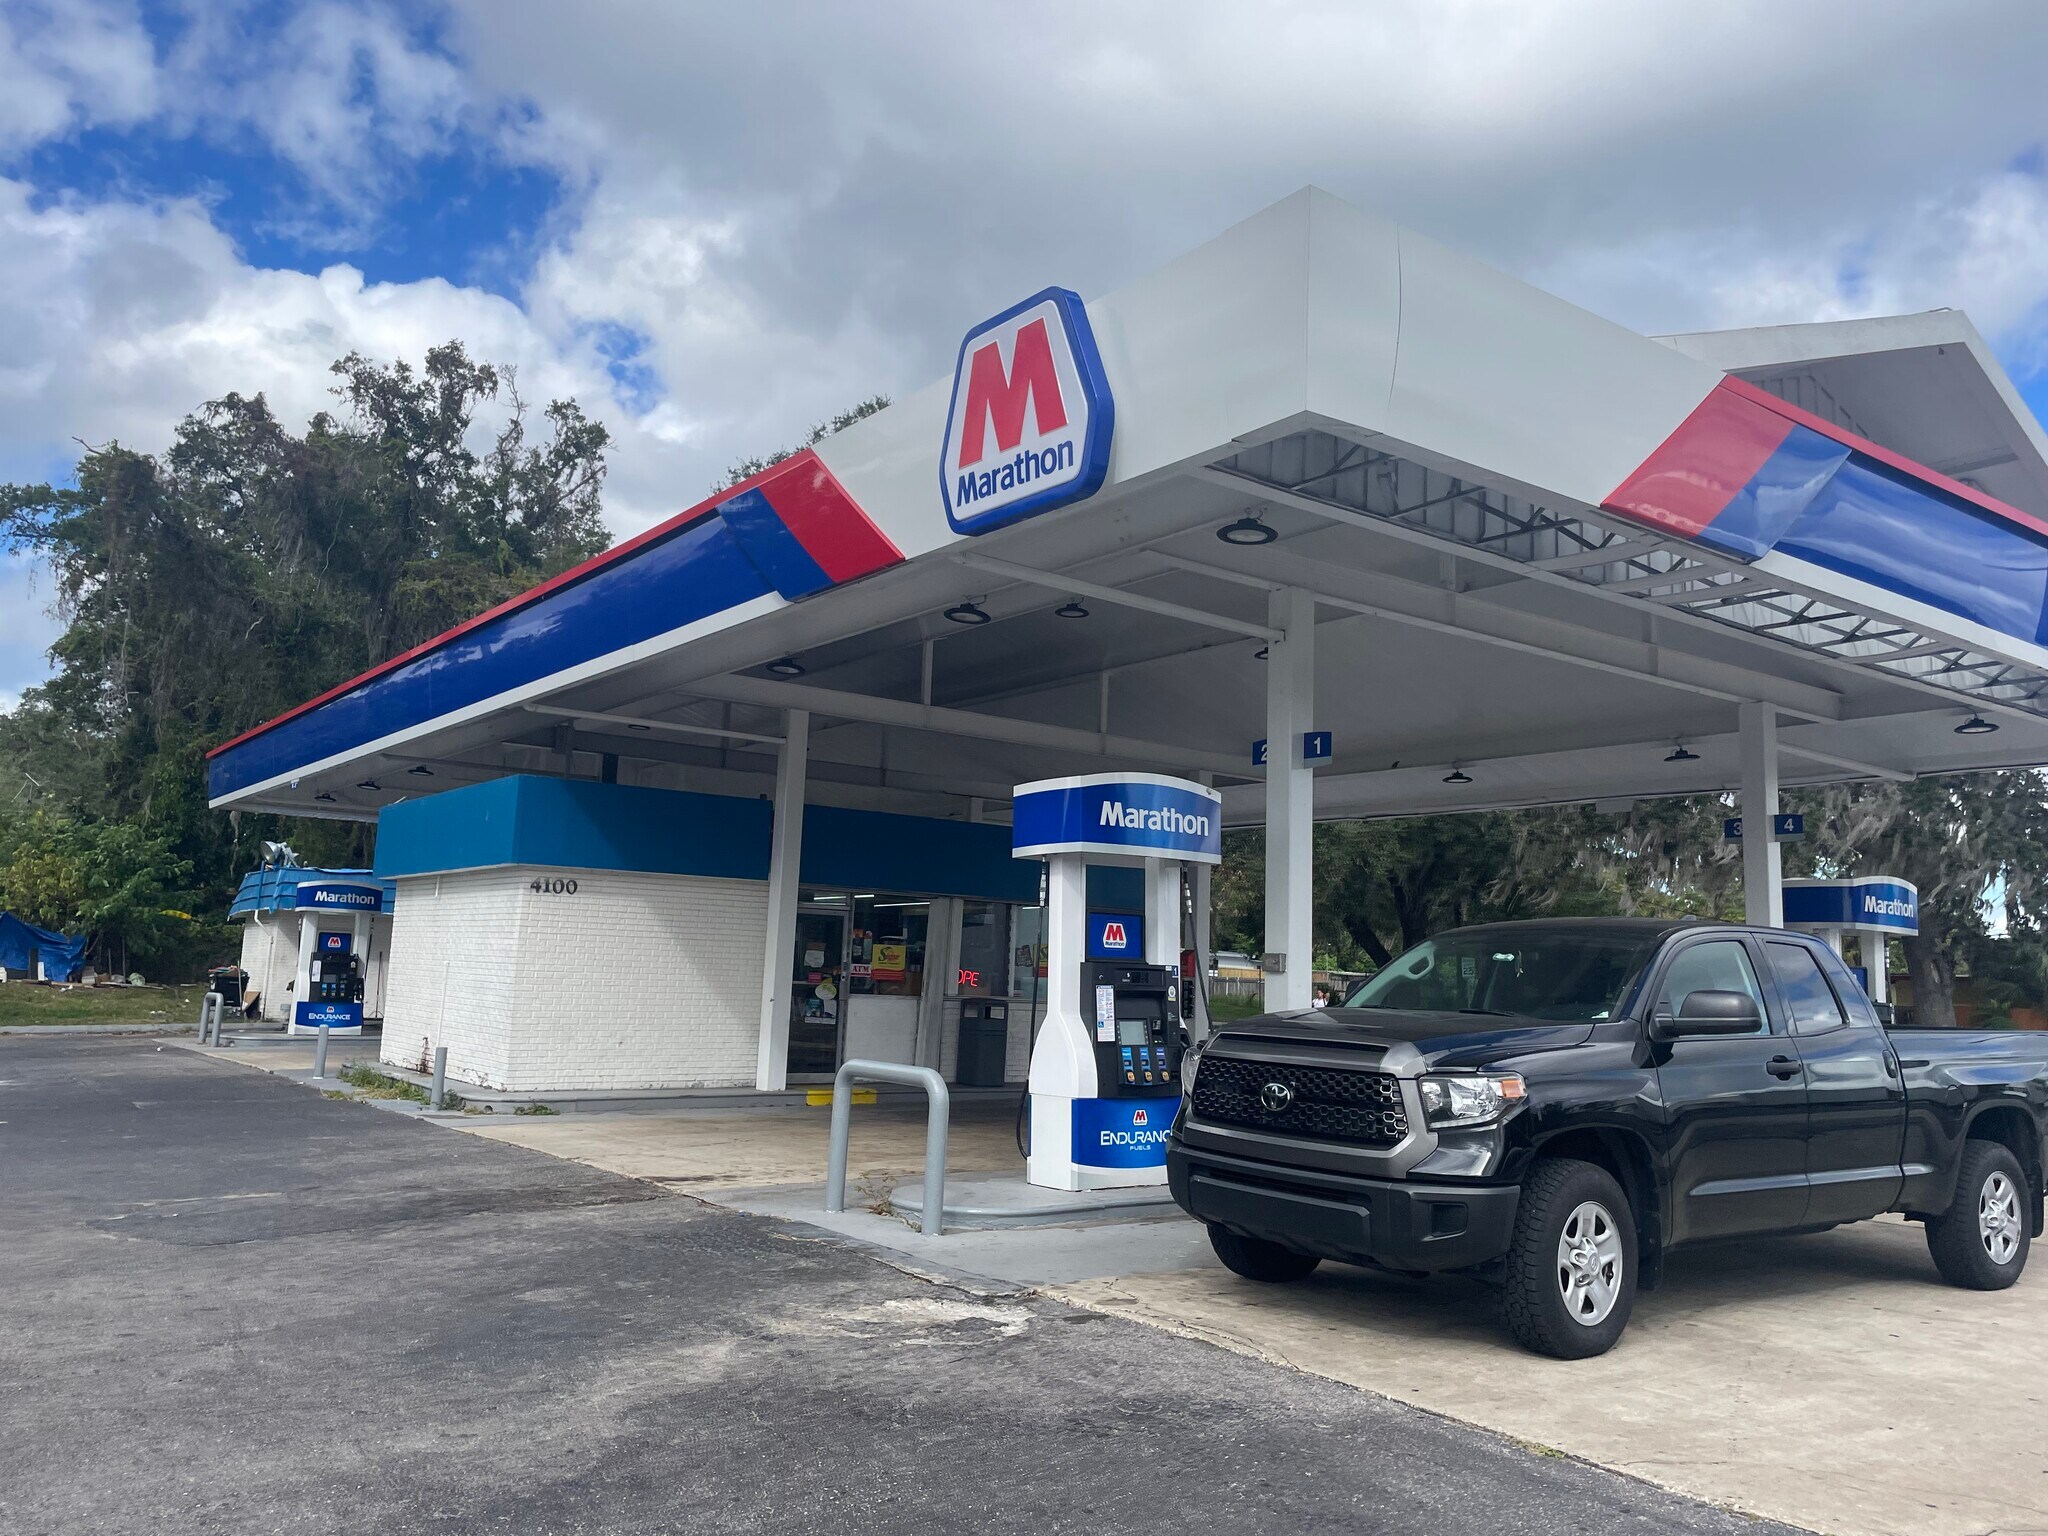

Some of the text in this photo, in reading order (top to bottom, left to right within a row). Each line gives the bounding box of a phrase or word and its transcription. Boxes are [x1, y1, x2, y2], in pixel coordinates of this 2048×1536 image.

[959, 317, 1068, 470] M
[956, 440, 1074, 507] Marathon
[1313, 736, 1321, 755] 1
[1100, 800, 1209, 837] Marathon
[1783, 818, 1795, 832] 4
[1733, 822, 1743, 836] 3
[530, 876, 578, 895] 4100
[314, 890, 375, 905] Marathon
[1864, 895, 1914, 918] Marathon
[1105, 924, 1124, 941] M
[852, 965, 870, 973] ATM
[1135, 1110, 1147, 1121] M
